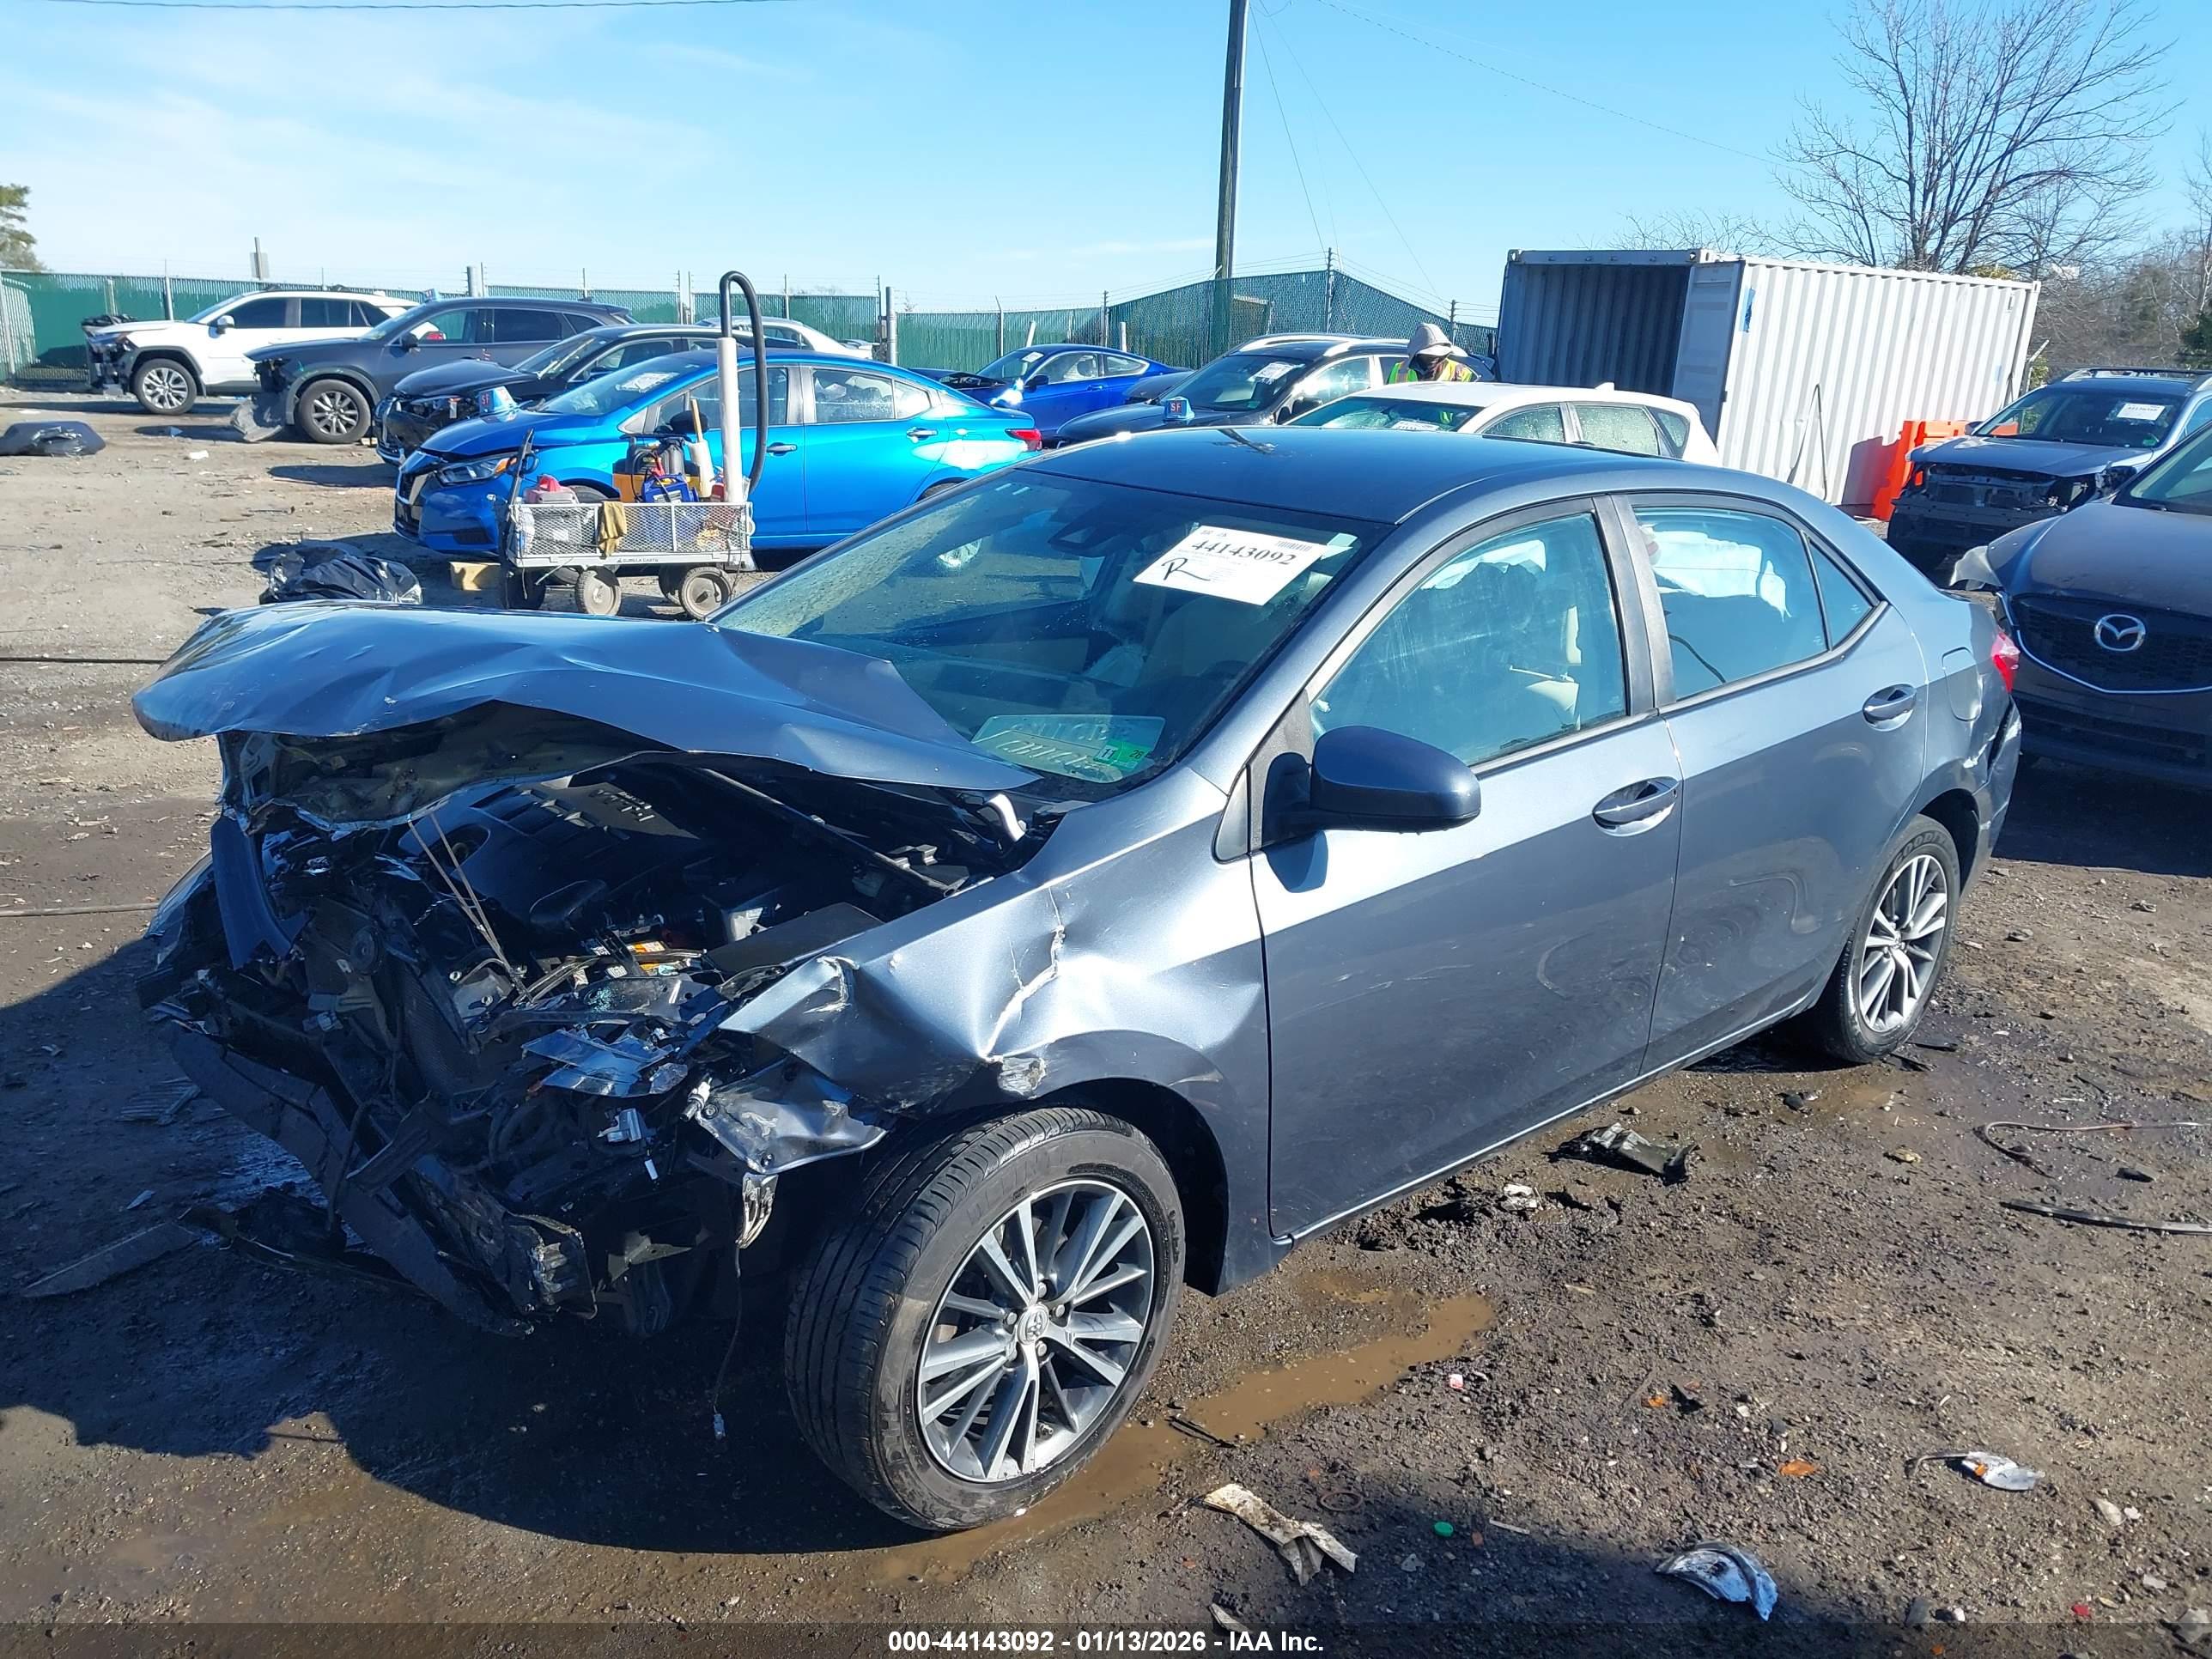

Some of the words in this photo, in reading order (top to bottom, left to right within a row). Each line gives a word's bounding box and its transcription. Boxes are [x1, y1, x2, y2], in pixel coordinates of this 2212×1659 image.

[1170, 403, 1182, 412] SF
[1192, 540, 1297, 565] 44143092
[1161, 557, 1212, 580] R
